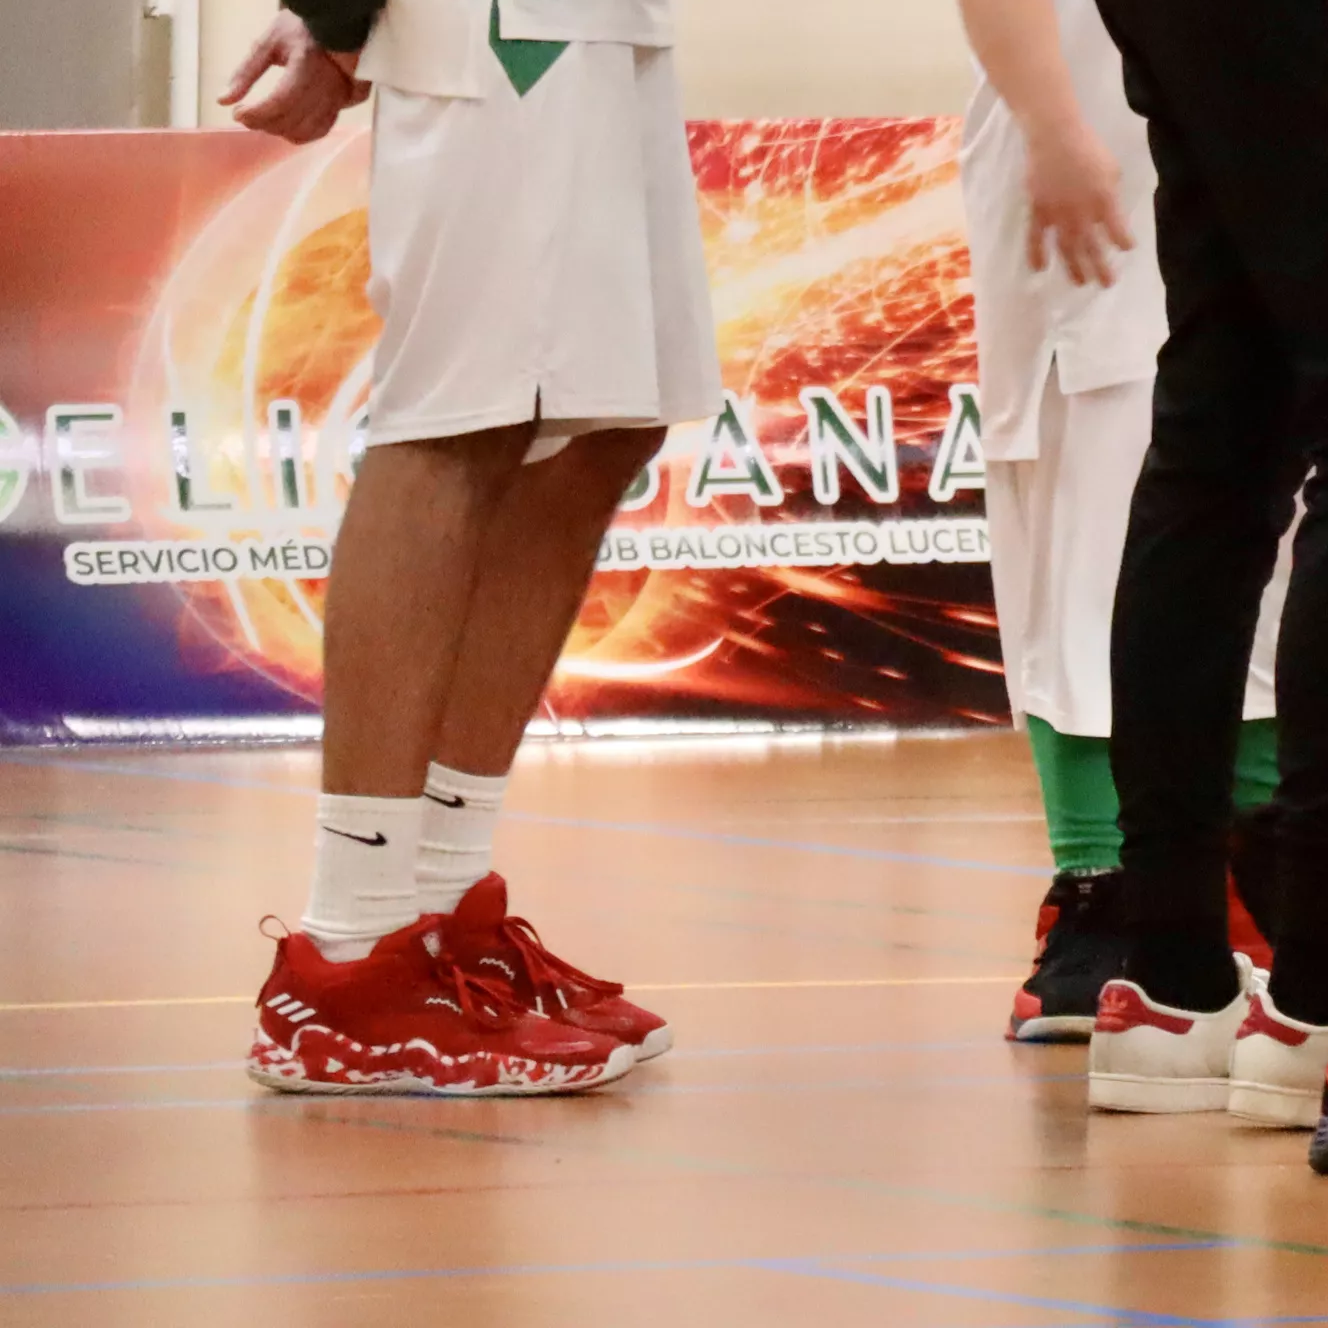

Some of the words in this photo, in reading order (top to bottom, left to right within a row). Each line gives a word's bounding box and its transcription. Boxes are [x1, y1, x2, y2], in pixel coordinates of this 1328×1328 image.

[73, 546, 238, 577] SERVICIO
[250, 539, 329, 572] MÉD
[651, 529, 879, 562] BALONCESTO
[889, 527, 989, 556] LUCEN
